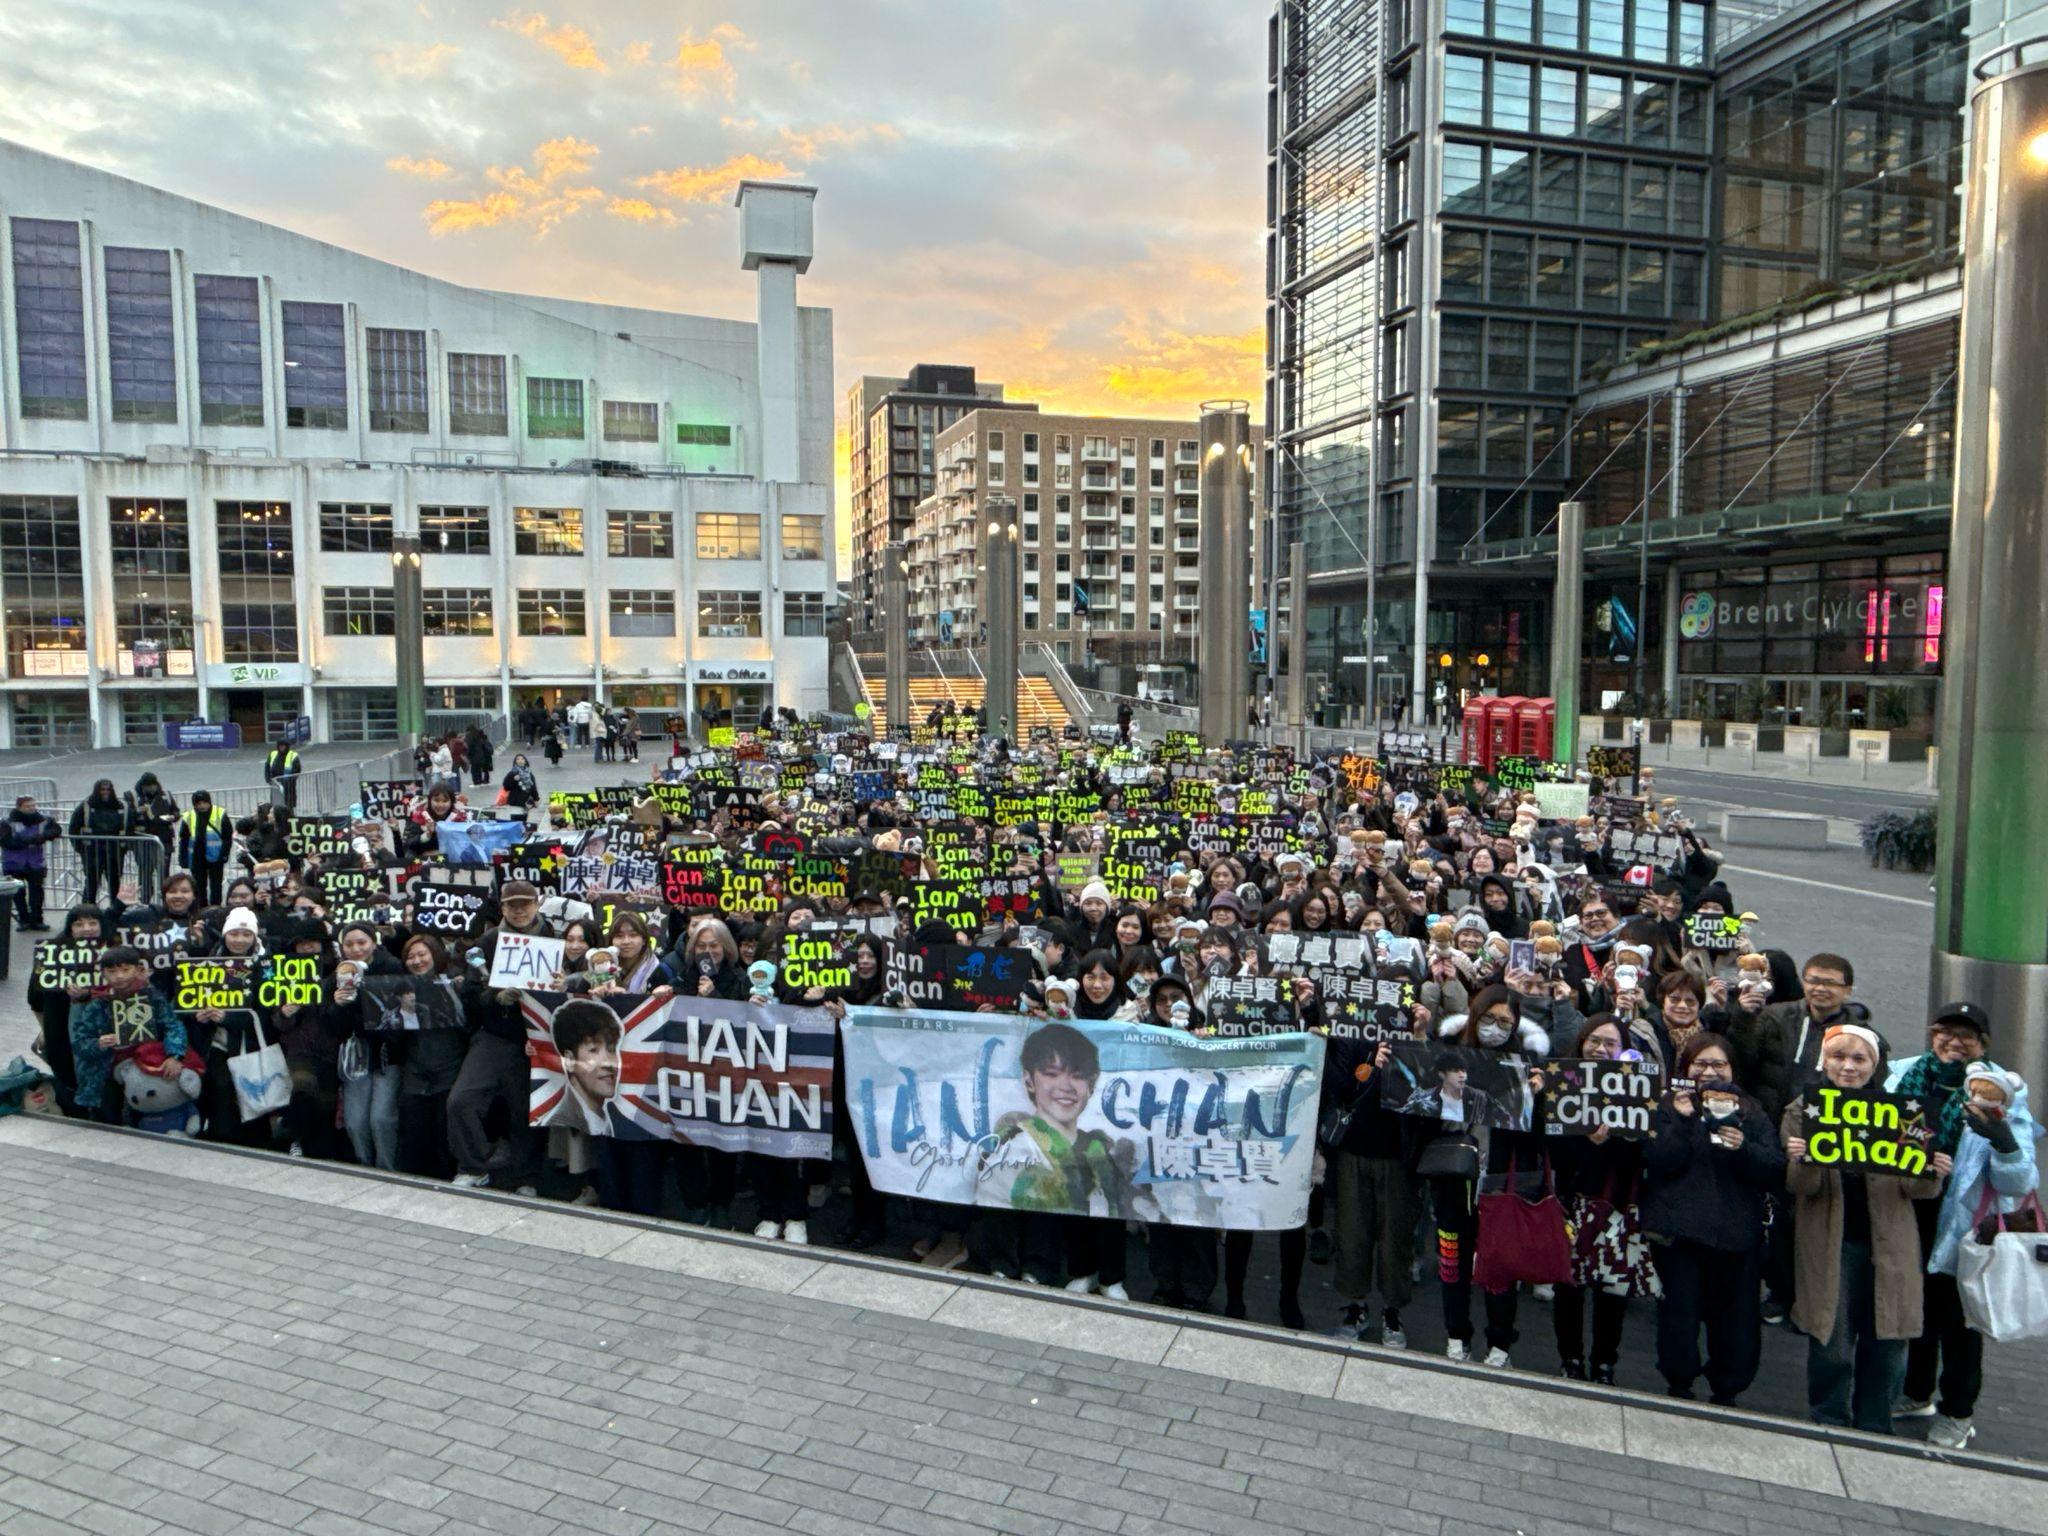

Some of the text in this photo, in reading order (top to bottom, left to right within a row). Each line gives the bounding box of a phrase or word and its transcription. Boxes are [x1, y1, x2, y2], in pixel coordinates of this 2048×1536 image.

[1719, 594, 1869, 629] Brent Civic
[255, 667, 279, 680] VIP
[699, 668, 766, 680] Box Office
[1253, 755, 1275, 768] Ian
[1507, 760, 1535, 776] Ian
[696, 768, 724, 780] Ian
[781, 774, 804, 787] Ian
[921, 764, 945, 780] Ian
[1253, 769, 1286, 782] Chan
[1448, 766, 1472, 778] Ian
[363, 786, 404, 804] Ian
[600, 787, 629, 802] Ian
[648, 784, 680, 799] Ian
[918, 790, 947, 806] Ian
[1125, 786, 1149, 799] Ian
[1180, 782, 1211, 798] Ian
[1241, 789, 1266, 802] Ian
[801, 797, 828, 815] Ian
[993, 795, 1022, 810] Ian
[1056, 791, 1088, 809] Ian
[1178, 797, 1219, 813] Chan
[1239, 802, 1273, 814] Chan
[920, 805, 956, 820] Chan
[287, 818, 333, 837] Ian
[609, 825, 645, 844] Ian
[1189, 818, 1220, 836] Ian
[1250, 821, 1284, 839] Ian
[927, 828, 959, 845] Ian
[1187, 835, 1231, 852] Chan
[1245, 837, 1289, 853] Chan
[287, 837, 349, 855] Chan
[935, 845, 969, 862] Ian
[1125, 840, 1162, 857] Ian
[743, 853, 776, 871] Ian
[793, 852, 833, 875] Ian
[1103, 857, 1145, 879] Ian
[501, 862, 541, 881] Ian
[663, 864, 704, 887] Ian
[722, 870, 763, 891] Ian
[937, 863, 984, 880] Chan
[324, 872, 366, 891] Ian
[789, 875, 845, 897] Chan
[420, 888, 464, 909] Ian
[665, 886, 718, 908] Chan
[720, 892, 779, 912] Chan
[915, 885, 959, 908] Ian
[435, 909, 477, 932] CCY
[1692, 914, 1724, 931] Ian
[116, 927, 170, 949] Ian
[785, 934, 833, 960] Ian
[43, 944, 92, 966] Ian
[500, 946, 559, 977] IAN
[886, 941, 924, 973] Ian
[176, 962, 225, 986] Ian
[273, 954, 317, 980] Ian
[784, 963, 851, 988] Chan
[886, 969, 944, 1001] Chan
[1209, 976, 1278, 1003] 陳卓賢
[1322, 974, 1402, 1008] 陳卓賢
[178, 986, 244, 1010] Chan
[258, 981, 322, 1008] Chan
[1244, 1006, 1266, 1019] HK
[1354, 1010, 1378, 1023] HK
[900, 1018, 955, 1032] TEARS
[1218, 1019, 1245, 1035] Ian
[1330, 1019, 1361, 1039] Ian
[686, 1015, 789, 1073] IAN
[1124, 1033, 1140, 1043] IAN
[1198, 1040, 1247, 1052] CONCERT
[1249, 1040, 1277, 1051] TOUR
[1640, 1064, 1659, 1075] UK
[1578, 1062, 1651, 1098] Ian
[657, 1066, 822, 1130] CHAN
[859, 1036, 1006, 1159] IAN
[1100, 1062, 1312, 1141] CHAN
[1556, 1094, 1650, 1131] Chan
[1818, 1088, 1900, 1129] Ian
[1546, 1124, 1562, 1134] HK
[1905, 1125, 1928, 1141] UK
[1809, 1127, 1928, 1175] Chan
